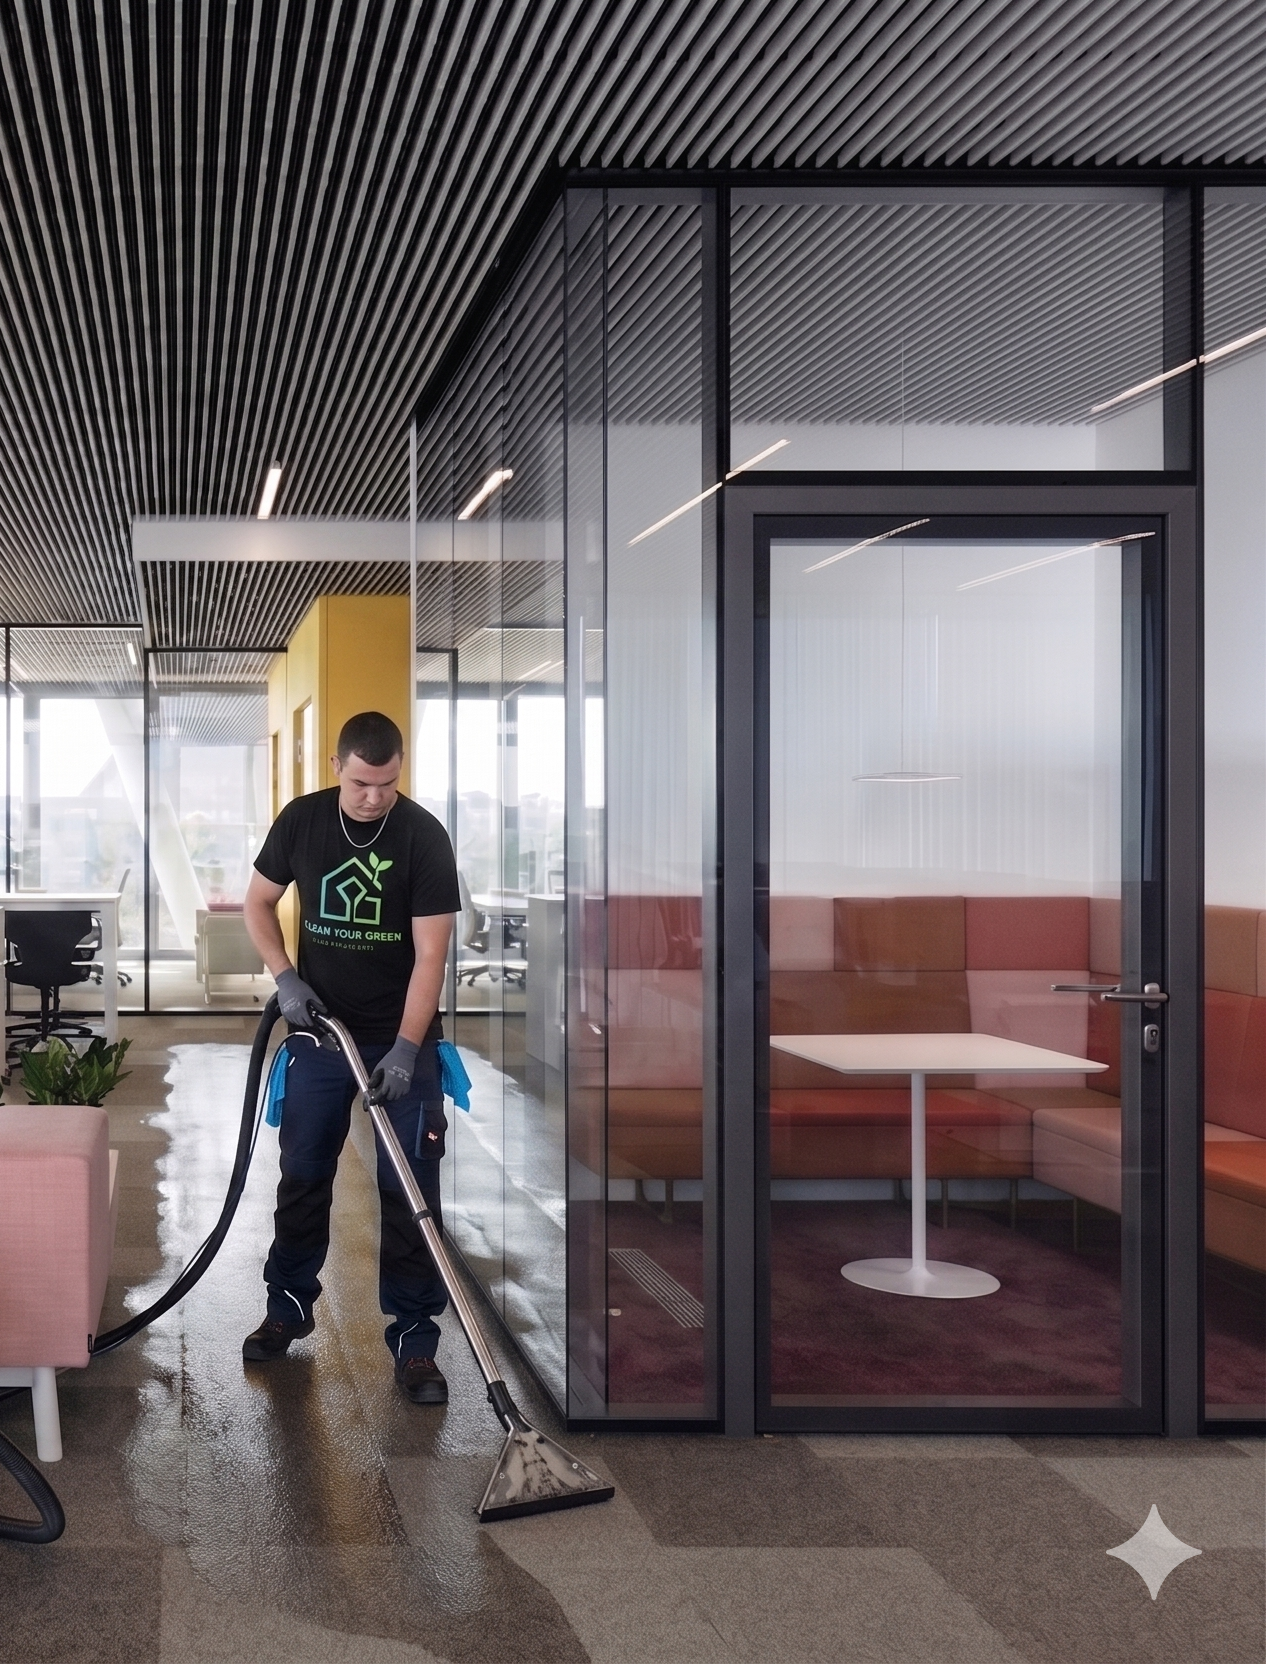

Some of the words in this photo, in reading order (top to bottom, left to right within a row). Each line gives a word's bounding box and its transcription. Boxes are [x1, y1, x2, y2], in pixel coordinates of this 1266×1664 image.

[305, 920, 331, 936] CLEAN
[334, 928, 362, 940] YOUR
[365, 931, 402, 941] GREEN
